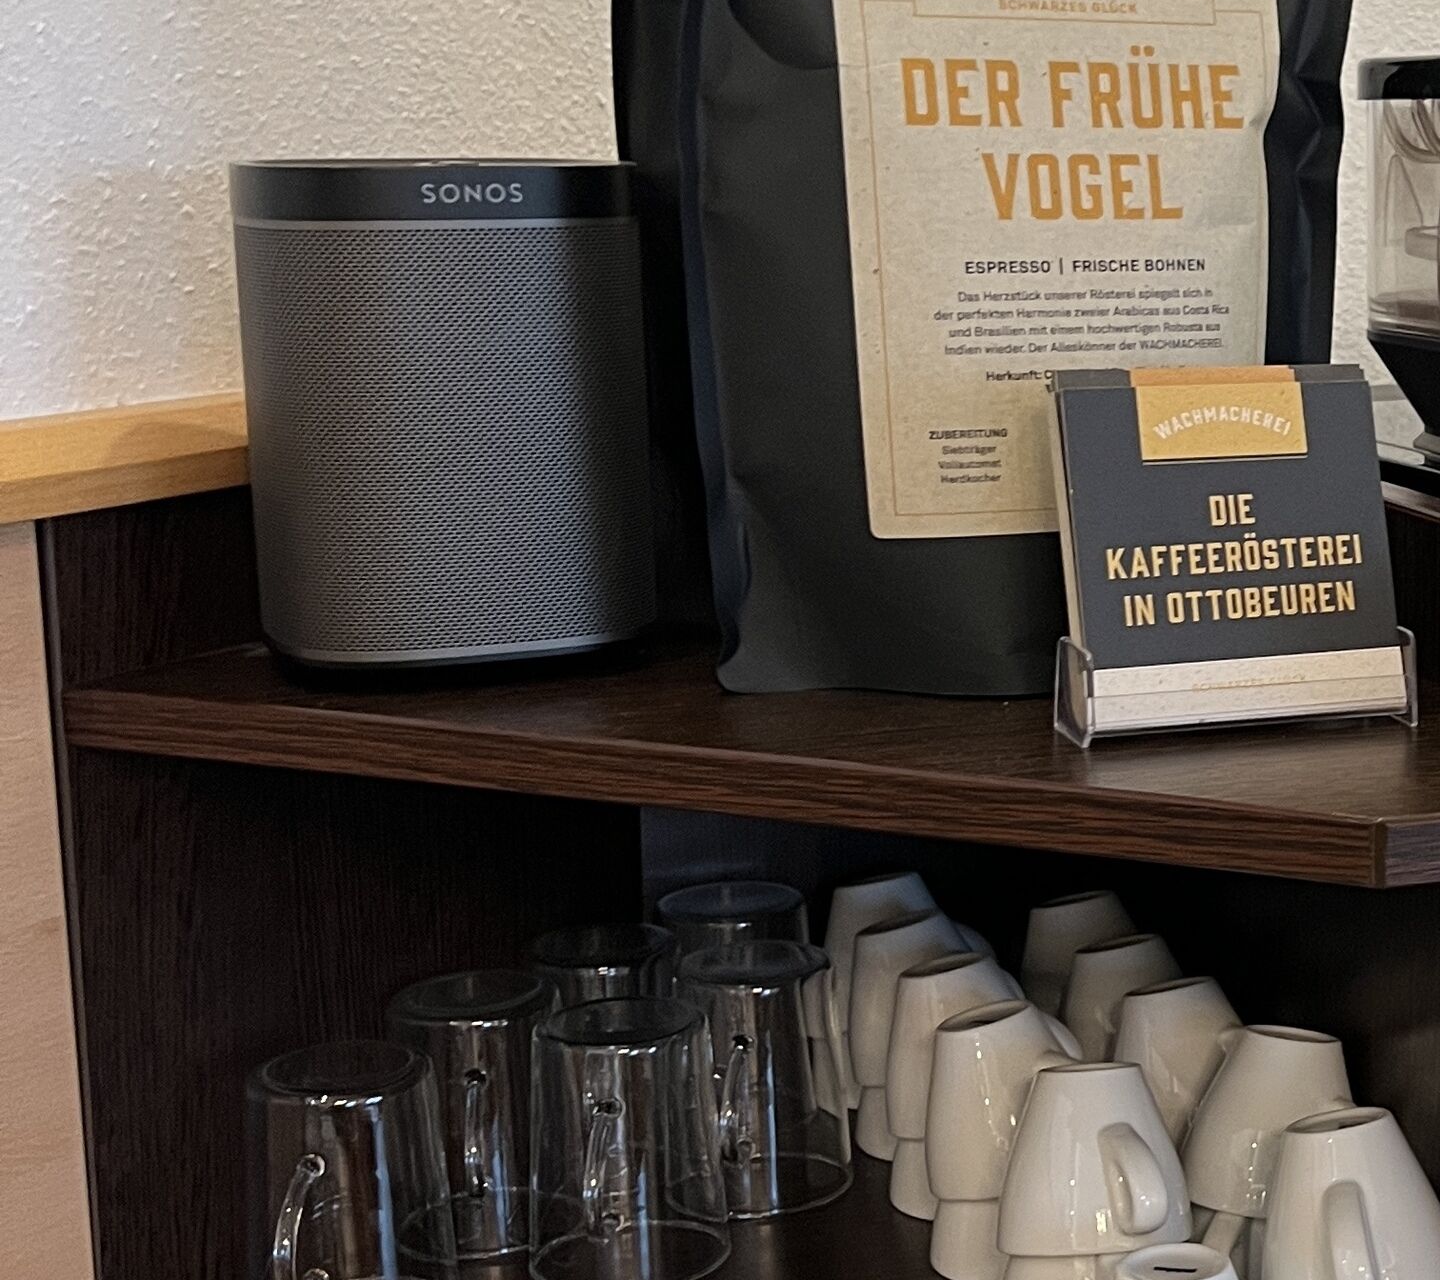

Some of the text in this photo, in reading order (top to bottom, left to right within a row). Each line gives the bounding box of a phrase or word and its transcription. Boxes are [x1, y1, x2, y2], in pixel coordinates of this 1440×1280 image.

[901, 45, 1246, 131] DER FRÜHE
[420, 182, 524, 204] SONOS
[981, 153, 1185, 221] VOGEL
[965, 258, 1206, 274] ESPRESSO FRISCHE BOHNEN
[928, 428, 1008, 440] ZUBEREITUNG
[1152, 405, 1292, 440] WACHMACHEREI
[1208, 493, 1257, 528] DIE
[1105, 532, 1364, 581] KAFFEERÖSTEREI
[1123, 579, 1357, 628] IN OTTOBEUREN
